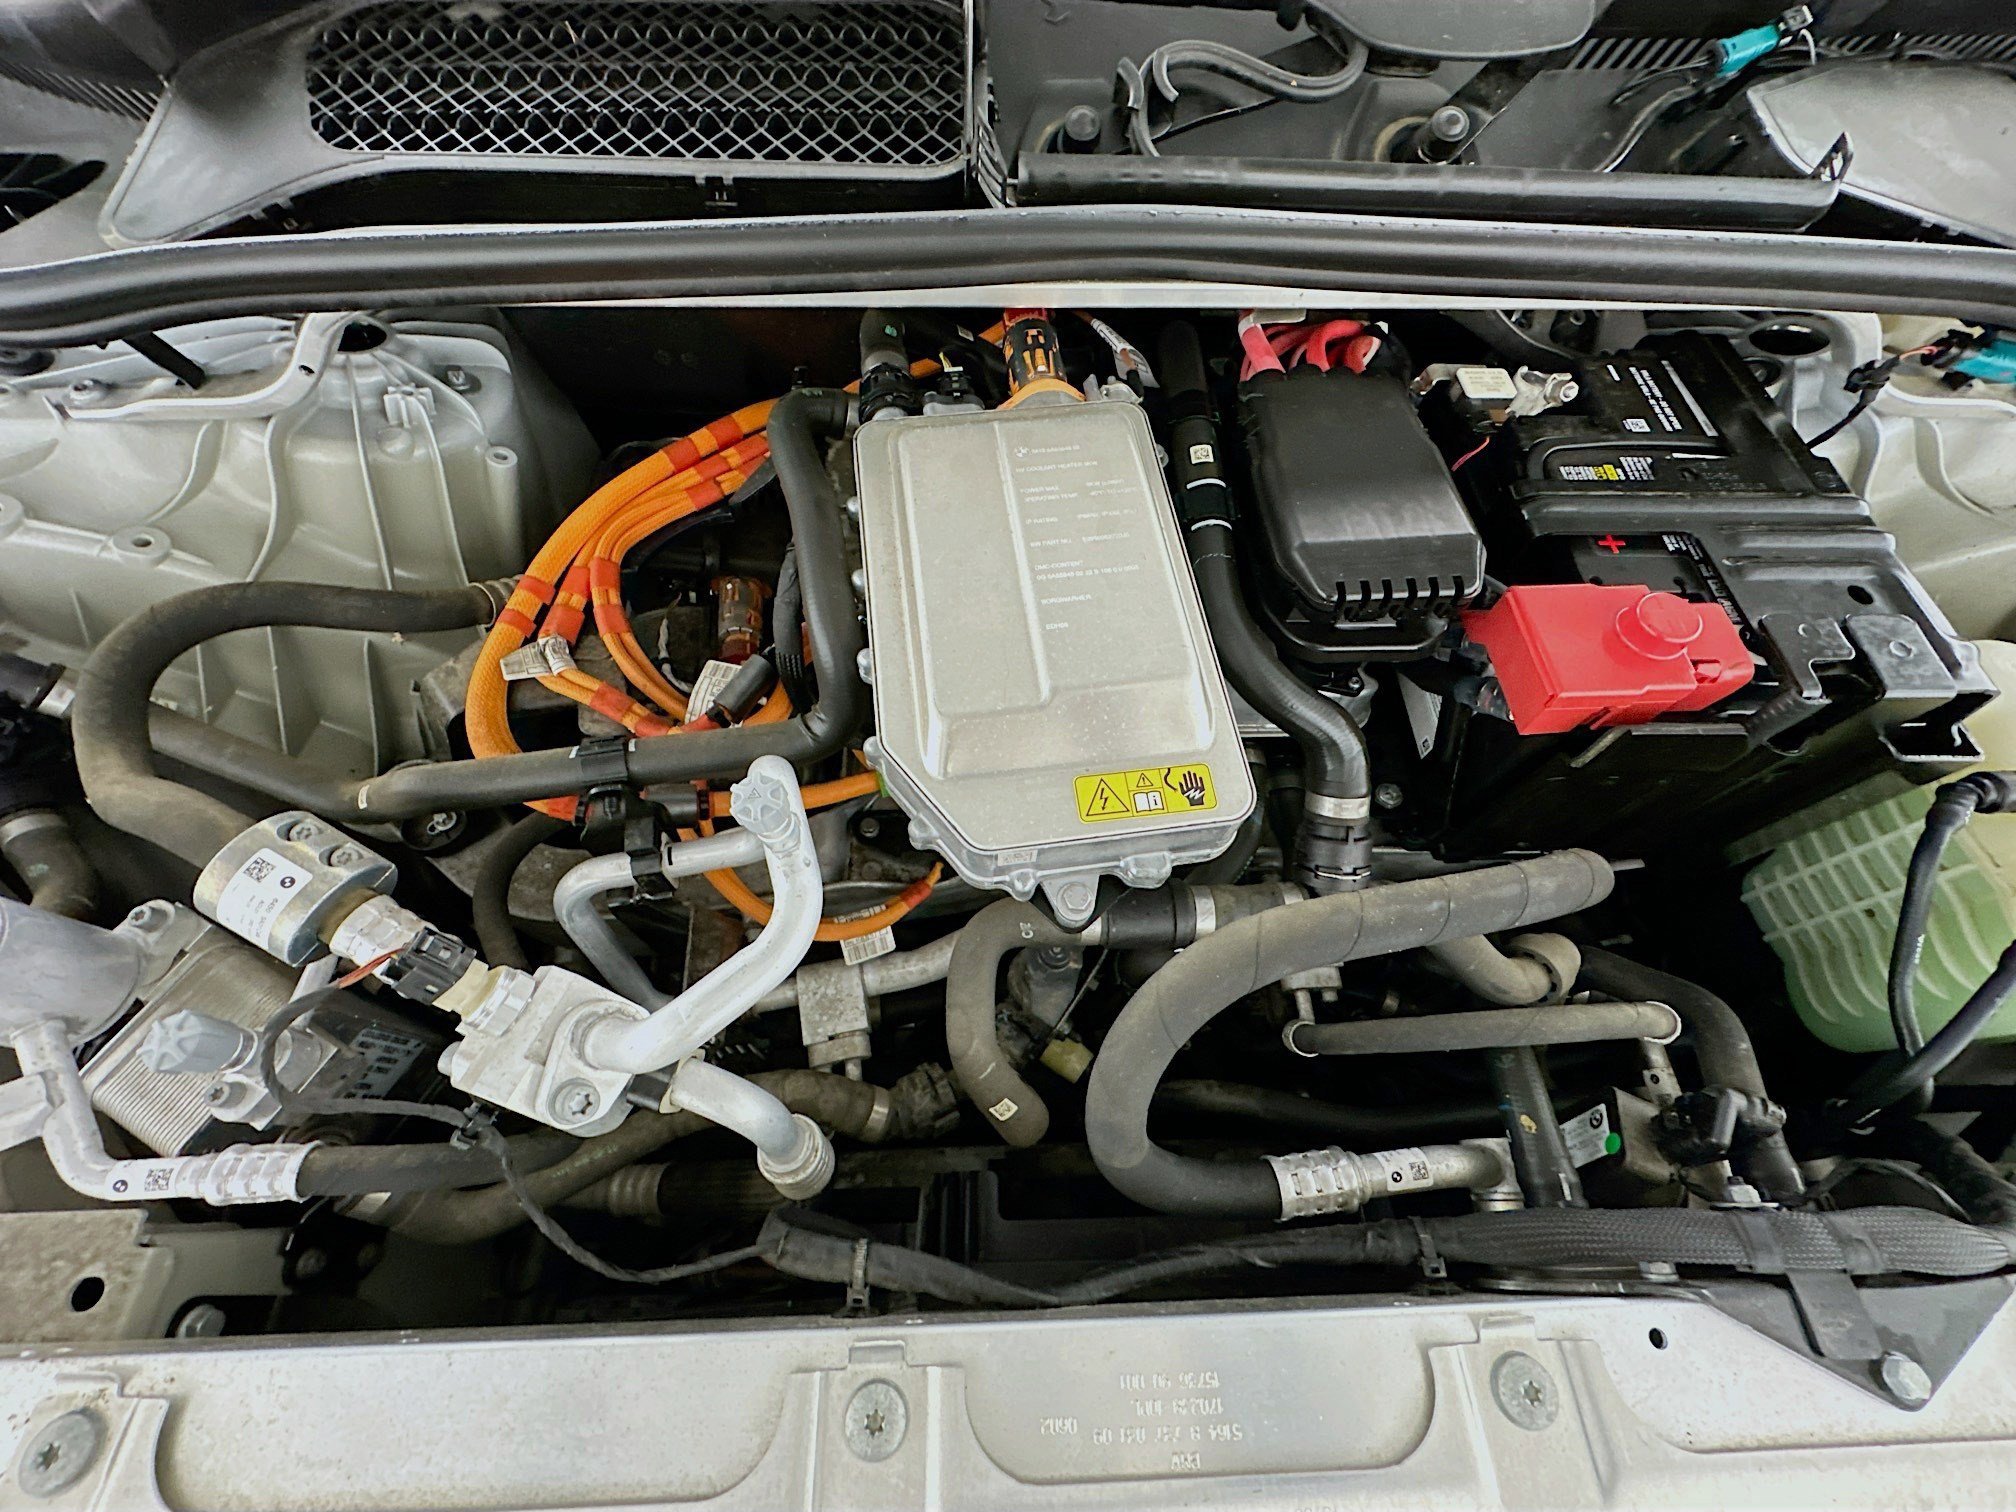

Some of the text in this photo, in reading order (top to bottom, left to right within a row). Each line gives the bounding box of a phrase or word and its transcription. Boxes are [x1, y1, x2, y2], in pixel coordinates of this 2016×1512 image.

[1026, 463, 1056, 472] COOLANT
[1057, 461, 1083, 470] HEATER
[1019, 486, 1043, 494] POWER
[1034, 560, 1084, 571] DMC-CONTENT
[1208, 1422, 1243, 1442] 5164
